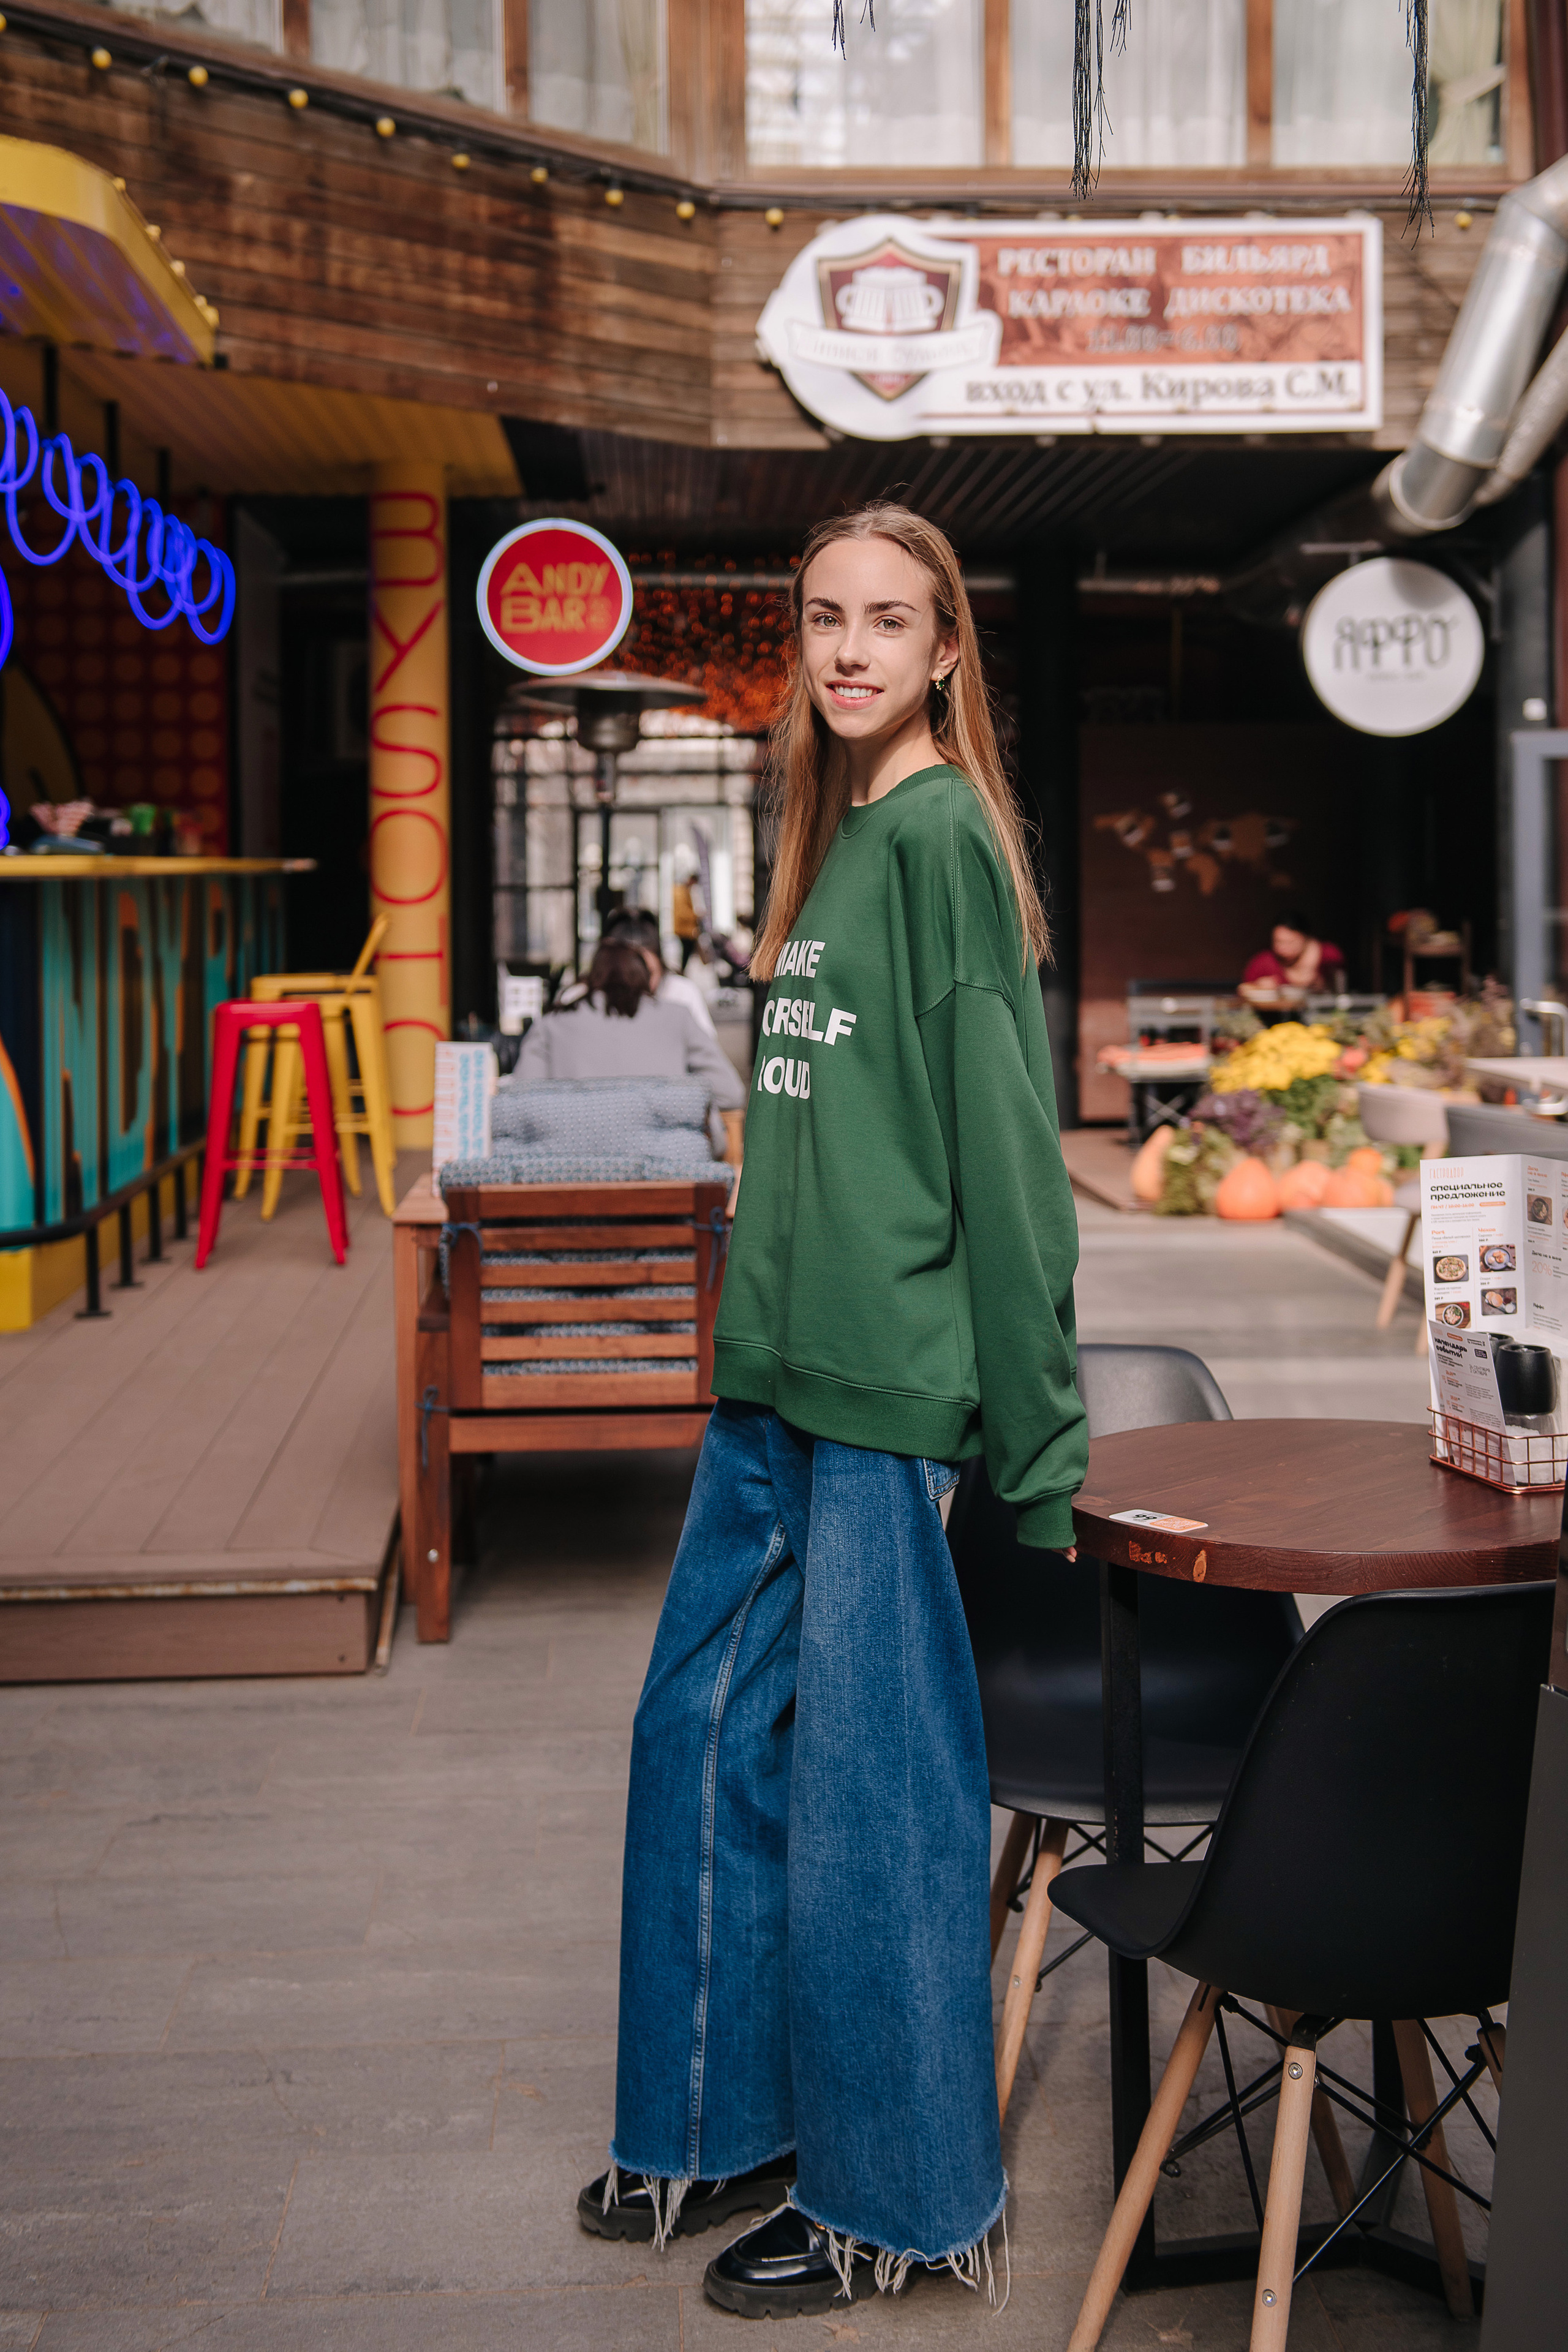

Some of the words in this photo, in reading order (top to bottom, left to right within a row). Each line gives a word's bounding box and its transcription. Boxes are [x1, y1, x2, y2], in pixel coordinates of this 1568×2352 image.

[997, 247, 1156, 277] РЕСТОРАН
[1181, 245, 1332, 277] БИЛЬЯРД
[1008, 288, 1152, 319] КАРАОКЕ
[1163, 285, 1352, 319] ДИСКОТЕКА
[965, 380, 1046, 404] вход
[1057, 380, 1075, 401] с
[1140, 373, 1276, 407] Кирова
[499, 561, 611, 596] ANDY
[757, 1055, 810, 1099] OUD
[1430, 1182, 1503, 1192] специальное
[1430, 1190, 1506, 1202] предложение
[1531, 1260, 1553, 1277] 20%
[1434, 1337, 1468, 1352] календарь
[1436, 1345, 1463, 1359] событий
